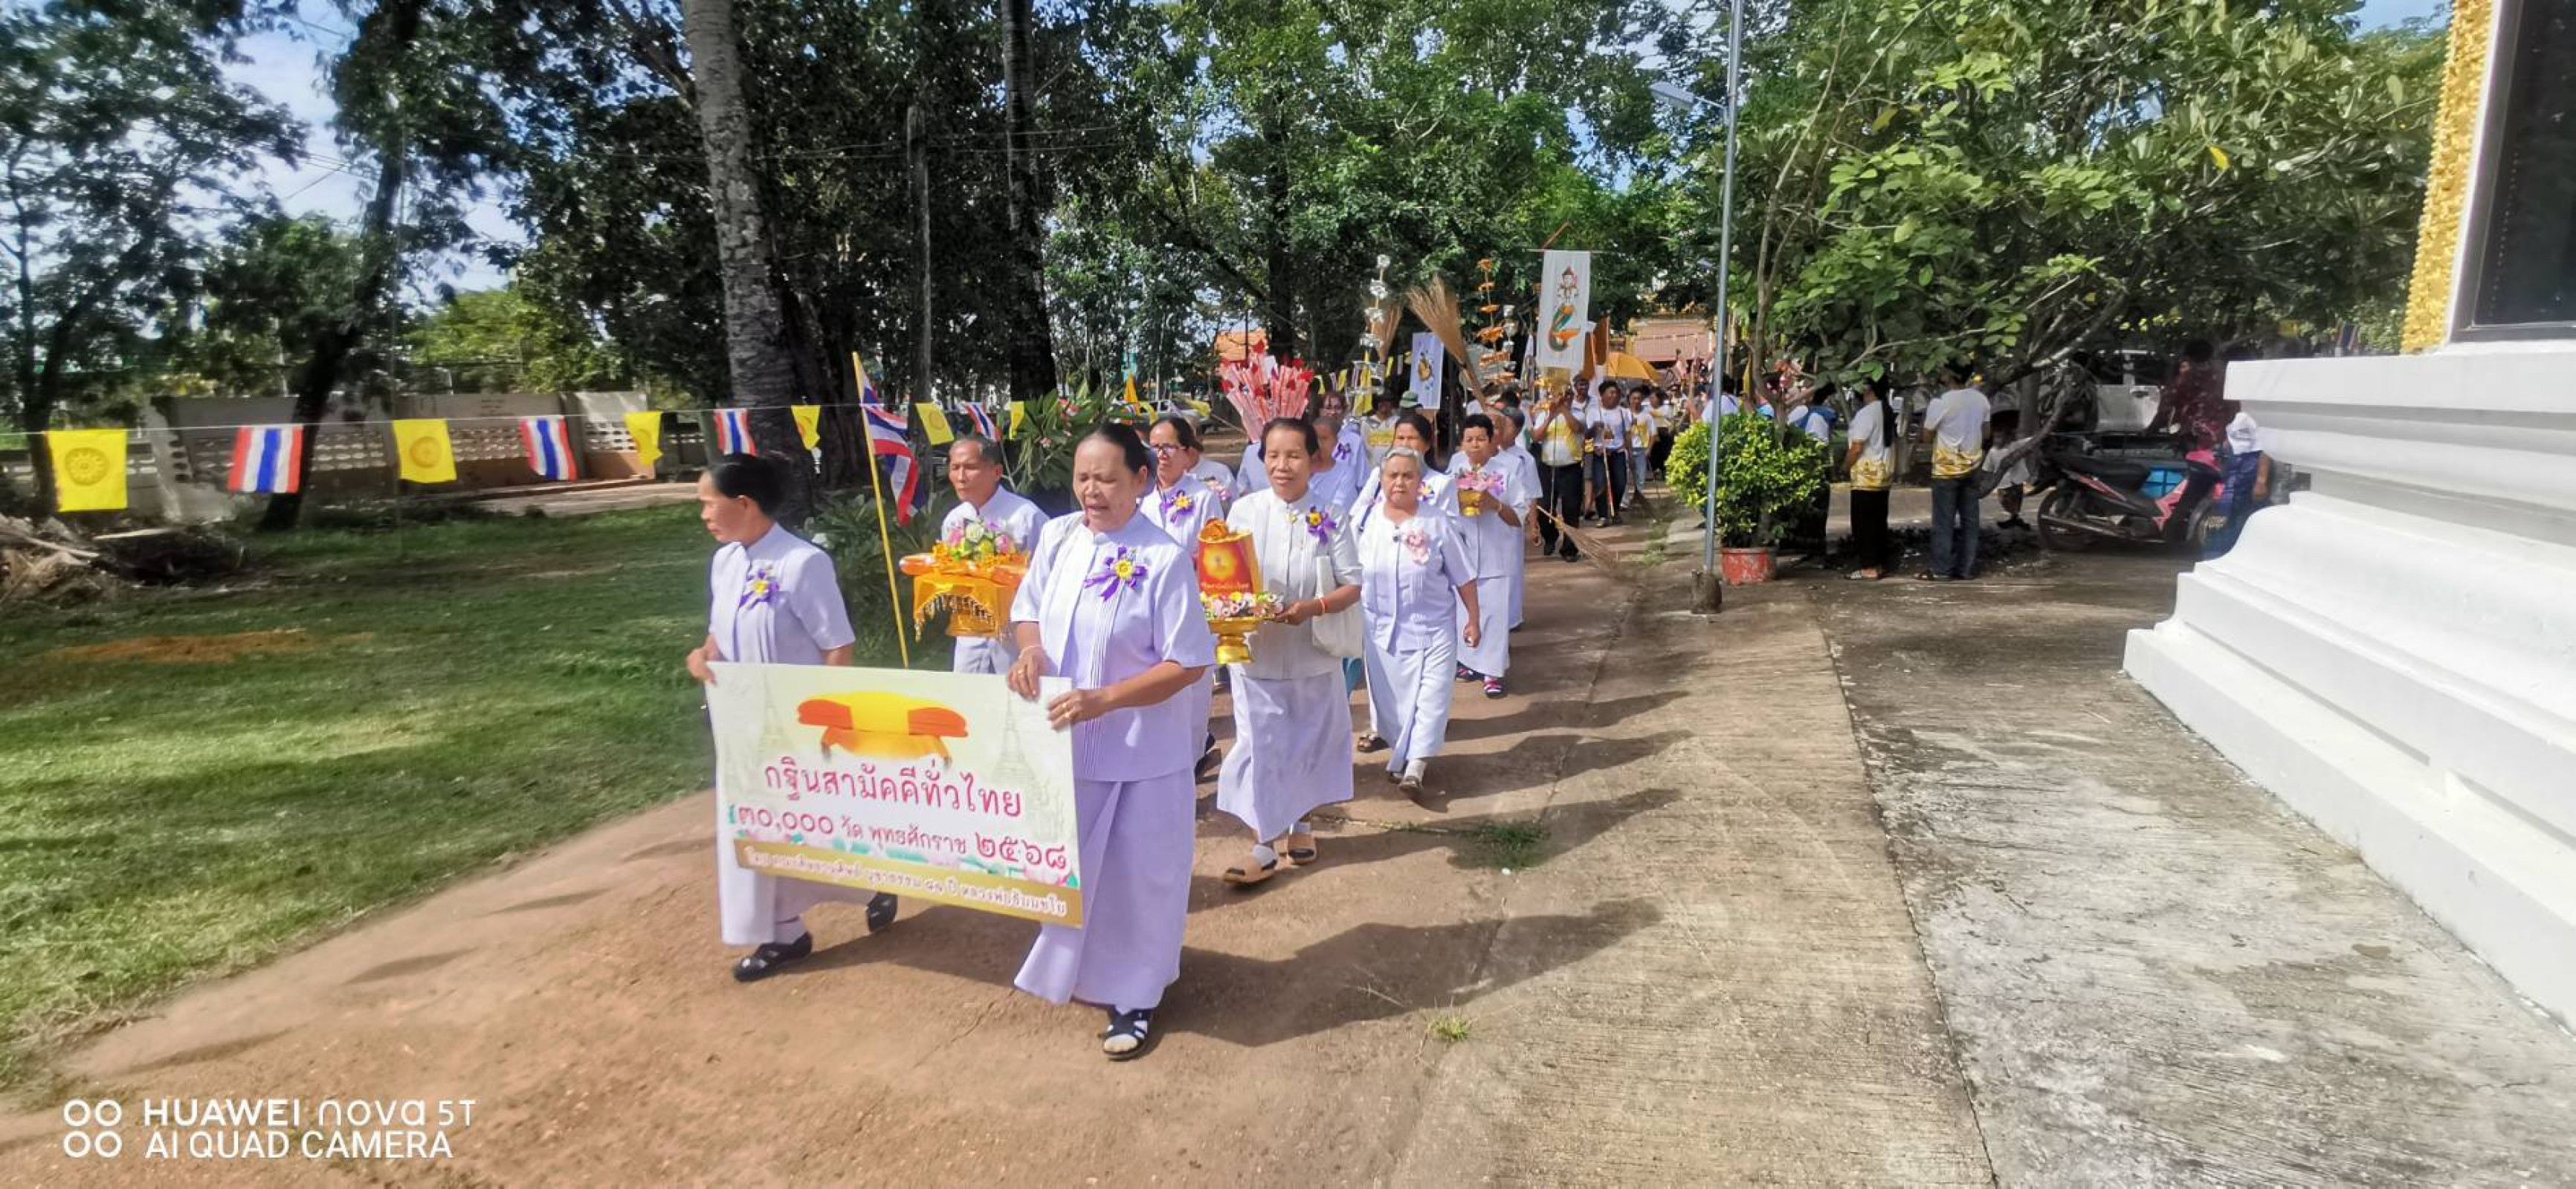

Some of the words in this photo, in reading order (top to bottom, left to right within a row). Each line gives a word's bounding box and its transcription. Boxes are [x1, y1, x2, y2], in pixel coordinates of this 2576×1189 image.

[765, 756, 1021, 817] กฐินสามัคคีทั่วไทย
[738, 806, 834, 835] ๓๐,๐๐๐
[975, 832, 1067, 869] ๒๕๖๘
